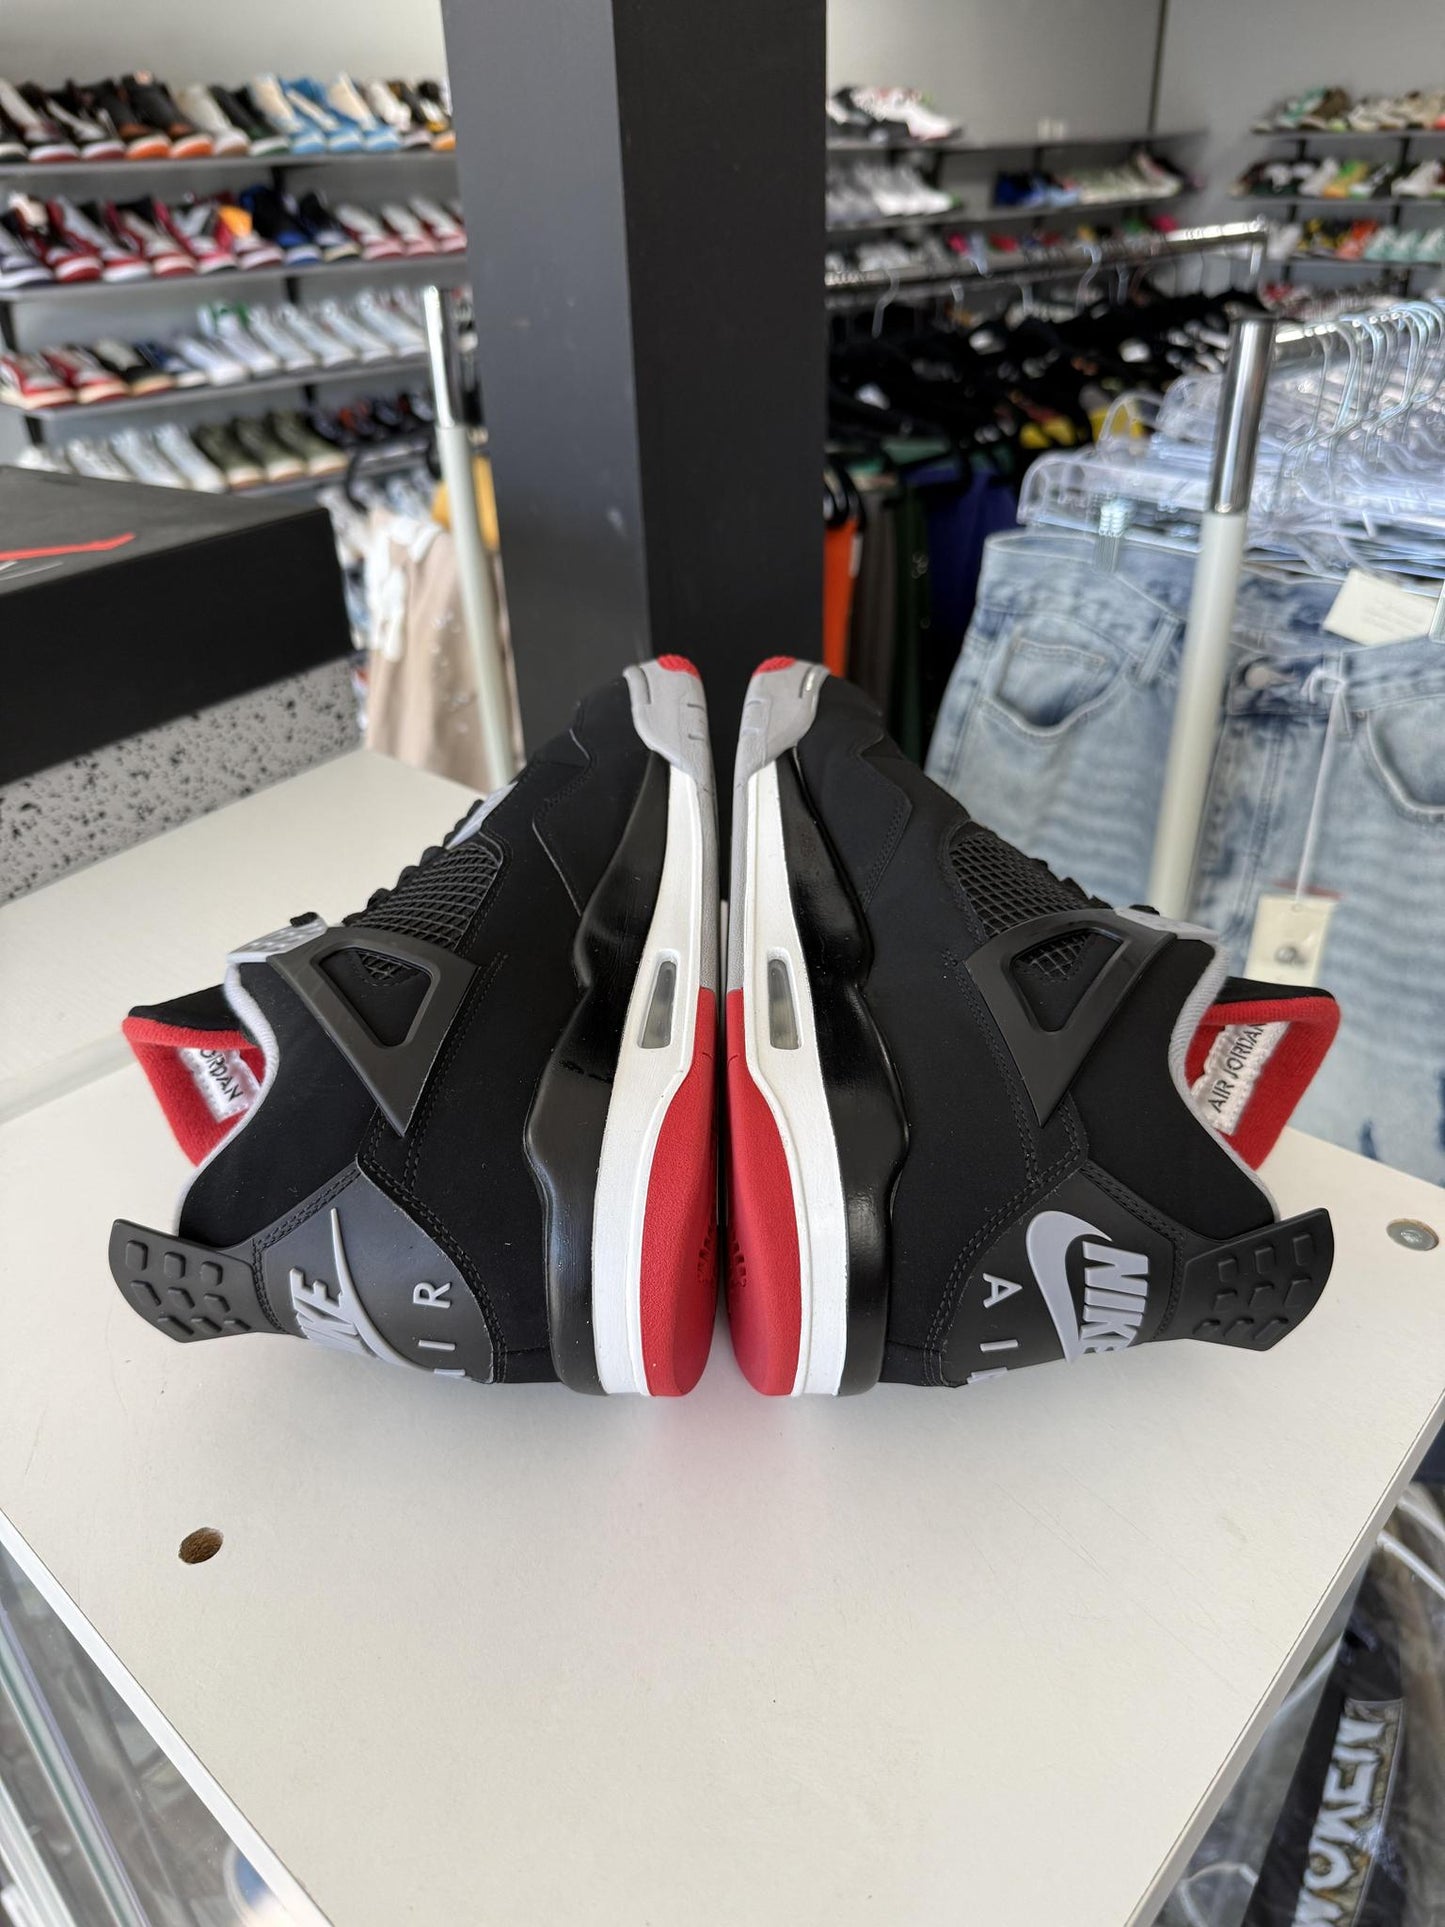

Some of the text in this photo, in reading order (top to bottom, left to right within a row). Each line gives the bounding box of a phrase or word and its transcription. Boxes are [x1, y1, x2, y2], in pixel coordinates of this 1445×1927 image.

[199, 1048, 245, 1103] ORDAN
[1207, 1079, 1236, 1114] AIR
[412, 1281, 466, 1377] IR
